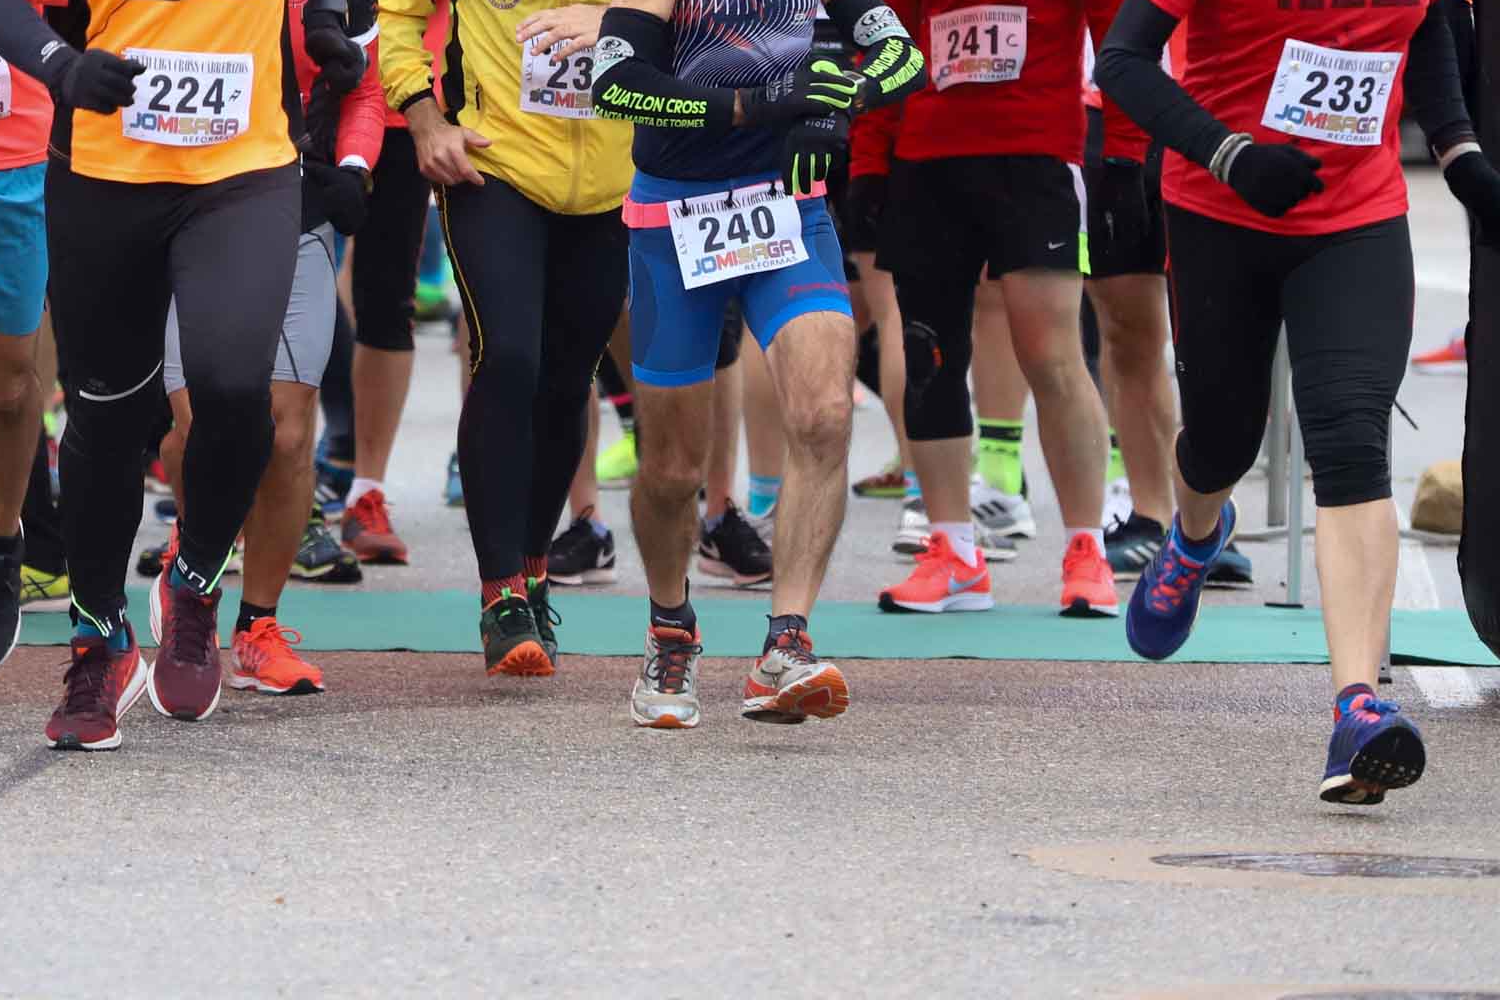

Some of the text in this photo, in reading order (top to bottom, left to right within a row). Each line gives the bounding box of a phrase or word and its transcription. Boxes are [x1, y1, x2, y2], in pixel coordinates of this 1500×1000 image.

[948, 24, 998, 60] 241
[148, 75, 225, 114] 224
[602, 83, 708, 115] DUATLON CROSS
[1299, 71, 1375, 114] 233
[130, 112, 239, 135] JOMISAGA
[656, 118, 669, 128] DE
[699, 205, 775, 254] 240
[692, 239, 796, 277] JOMISAGA
[745, 255, 798, 271] REFORMAS
